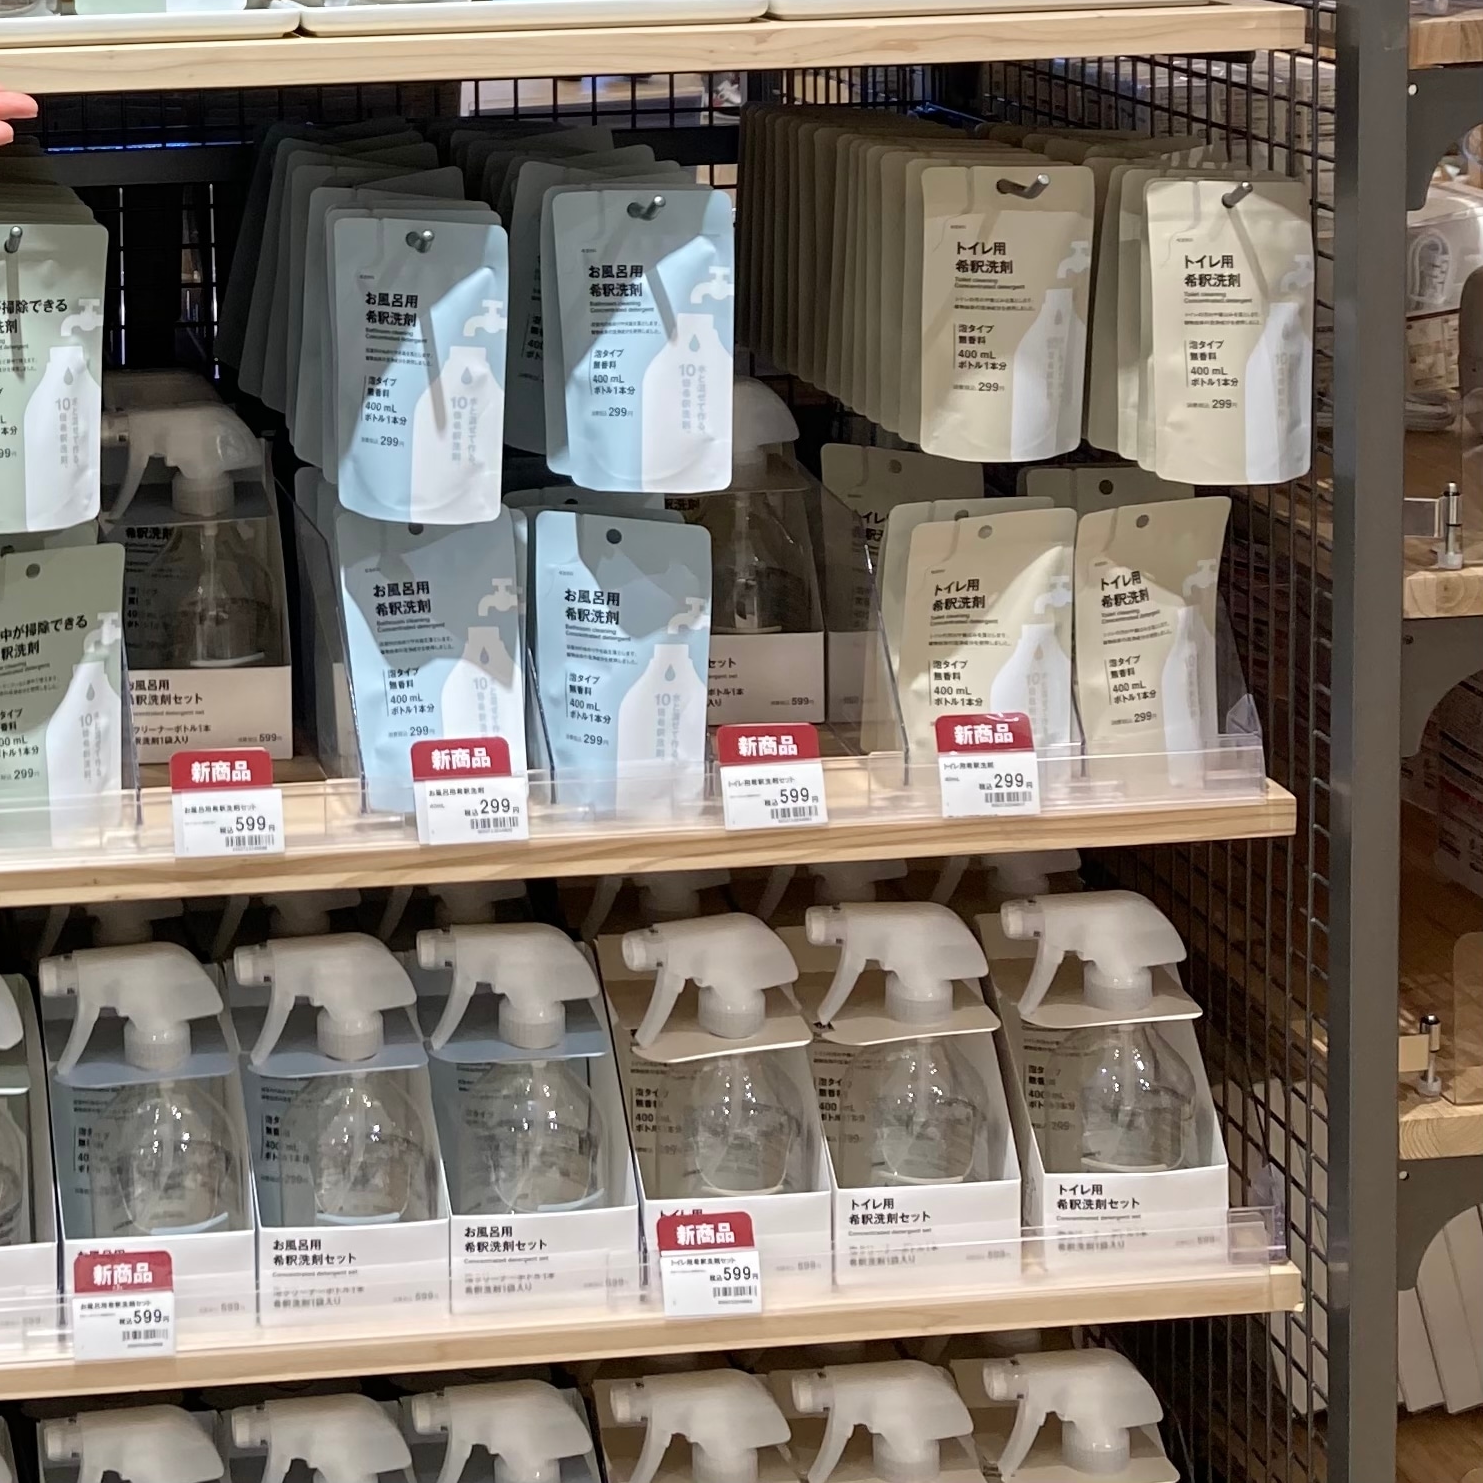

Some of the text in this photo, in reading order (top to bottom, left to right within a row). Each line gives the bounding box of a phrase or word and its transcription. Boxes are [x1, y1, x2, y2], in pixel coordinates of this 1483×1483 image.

[957, 241, 1006, 256] トイレ用
[955, 259, 1013, 274] 希釈洗剤
[1184, 255, 1233, 269] トイレ用
[588, 264, 643, 279] お風呂用
[1184, 272, 1241, 288] 希釈洗剤
[589, 282, 643, 298] 希釈洗剤
[365, 291, 418, 309] お風呂用
[365, 310, 416, 328] 希釈洗剤
[934, 579, 980, 597] トイレ用
[1101, 571, 1142, 591] トイレ用
[373, 581, 429, 599] お風呂用
[564, 588, 620, 607] お風呂用
[1101, 587, 1149, 609] 希釈洗剤
[375, 600, 431, 617] 希釈洗剤
[932, 595, 986, 612] 希釈洗剤
[565, 607, 619, 626] 希釈洗剤
[954, 722, 1014, 746] 新商品
[738, 734, 798, 758] 新商品
[431, 746, 491, 771] 新商品
[191, 760, 251, 783] 新商品
[1058, 1183, 1102, 1196] トイレ用
[850, 1198, 894, 1210] トイレ用
[1057, 1198, 1139, 1211] 希釈洗剤セット
[849, 1211, 931, 1226] 希釈洗剤セット
[464, 1225, 513, 1238] お風呂用
[676, 1223, 735, 1246] 新商品
[273, 1239, 322, 1252] お風呂用
[465, 1239, 548, 1253] 希釈洗剤セット
[273, 1252, 357, 1267] 希釈洗剤セット
[93, 1262, 153, 1286] 新商品
